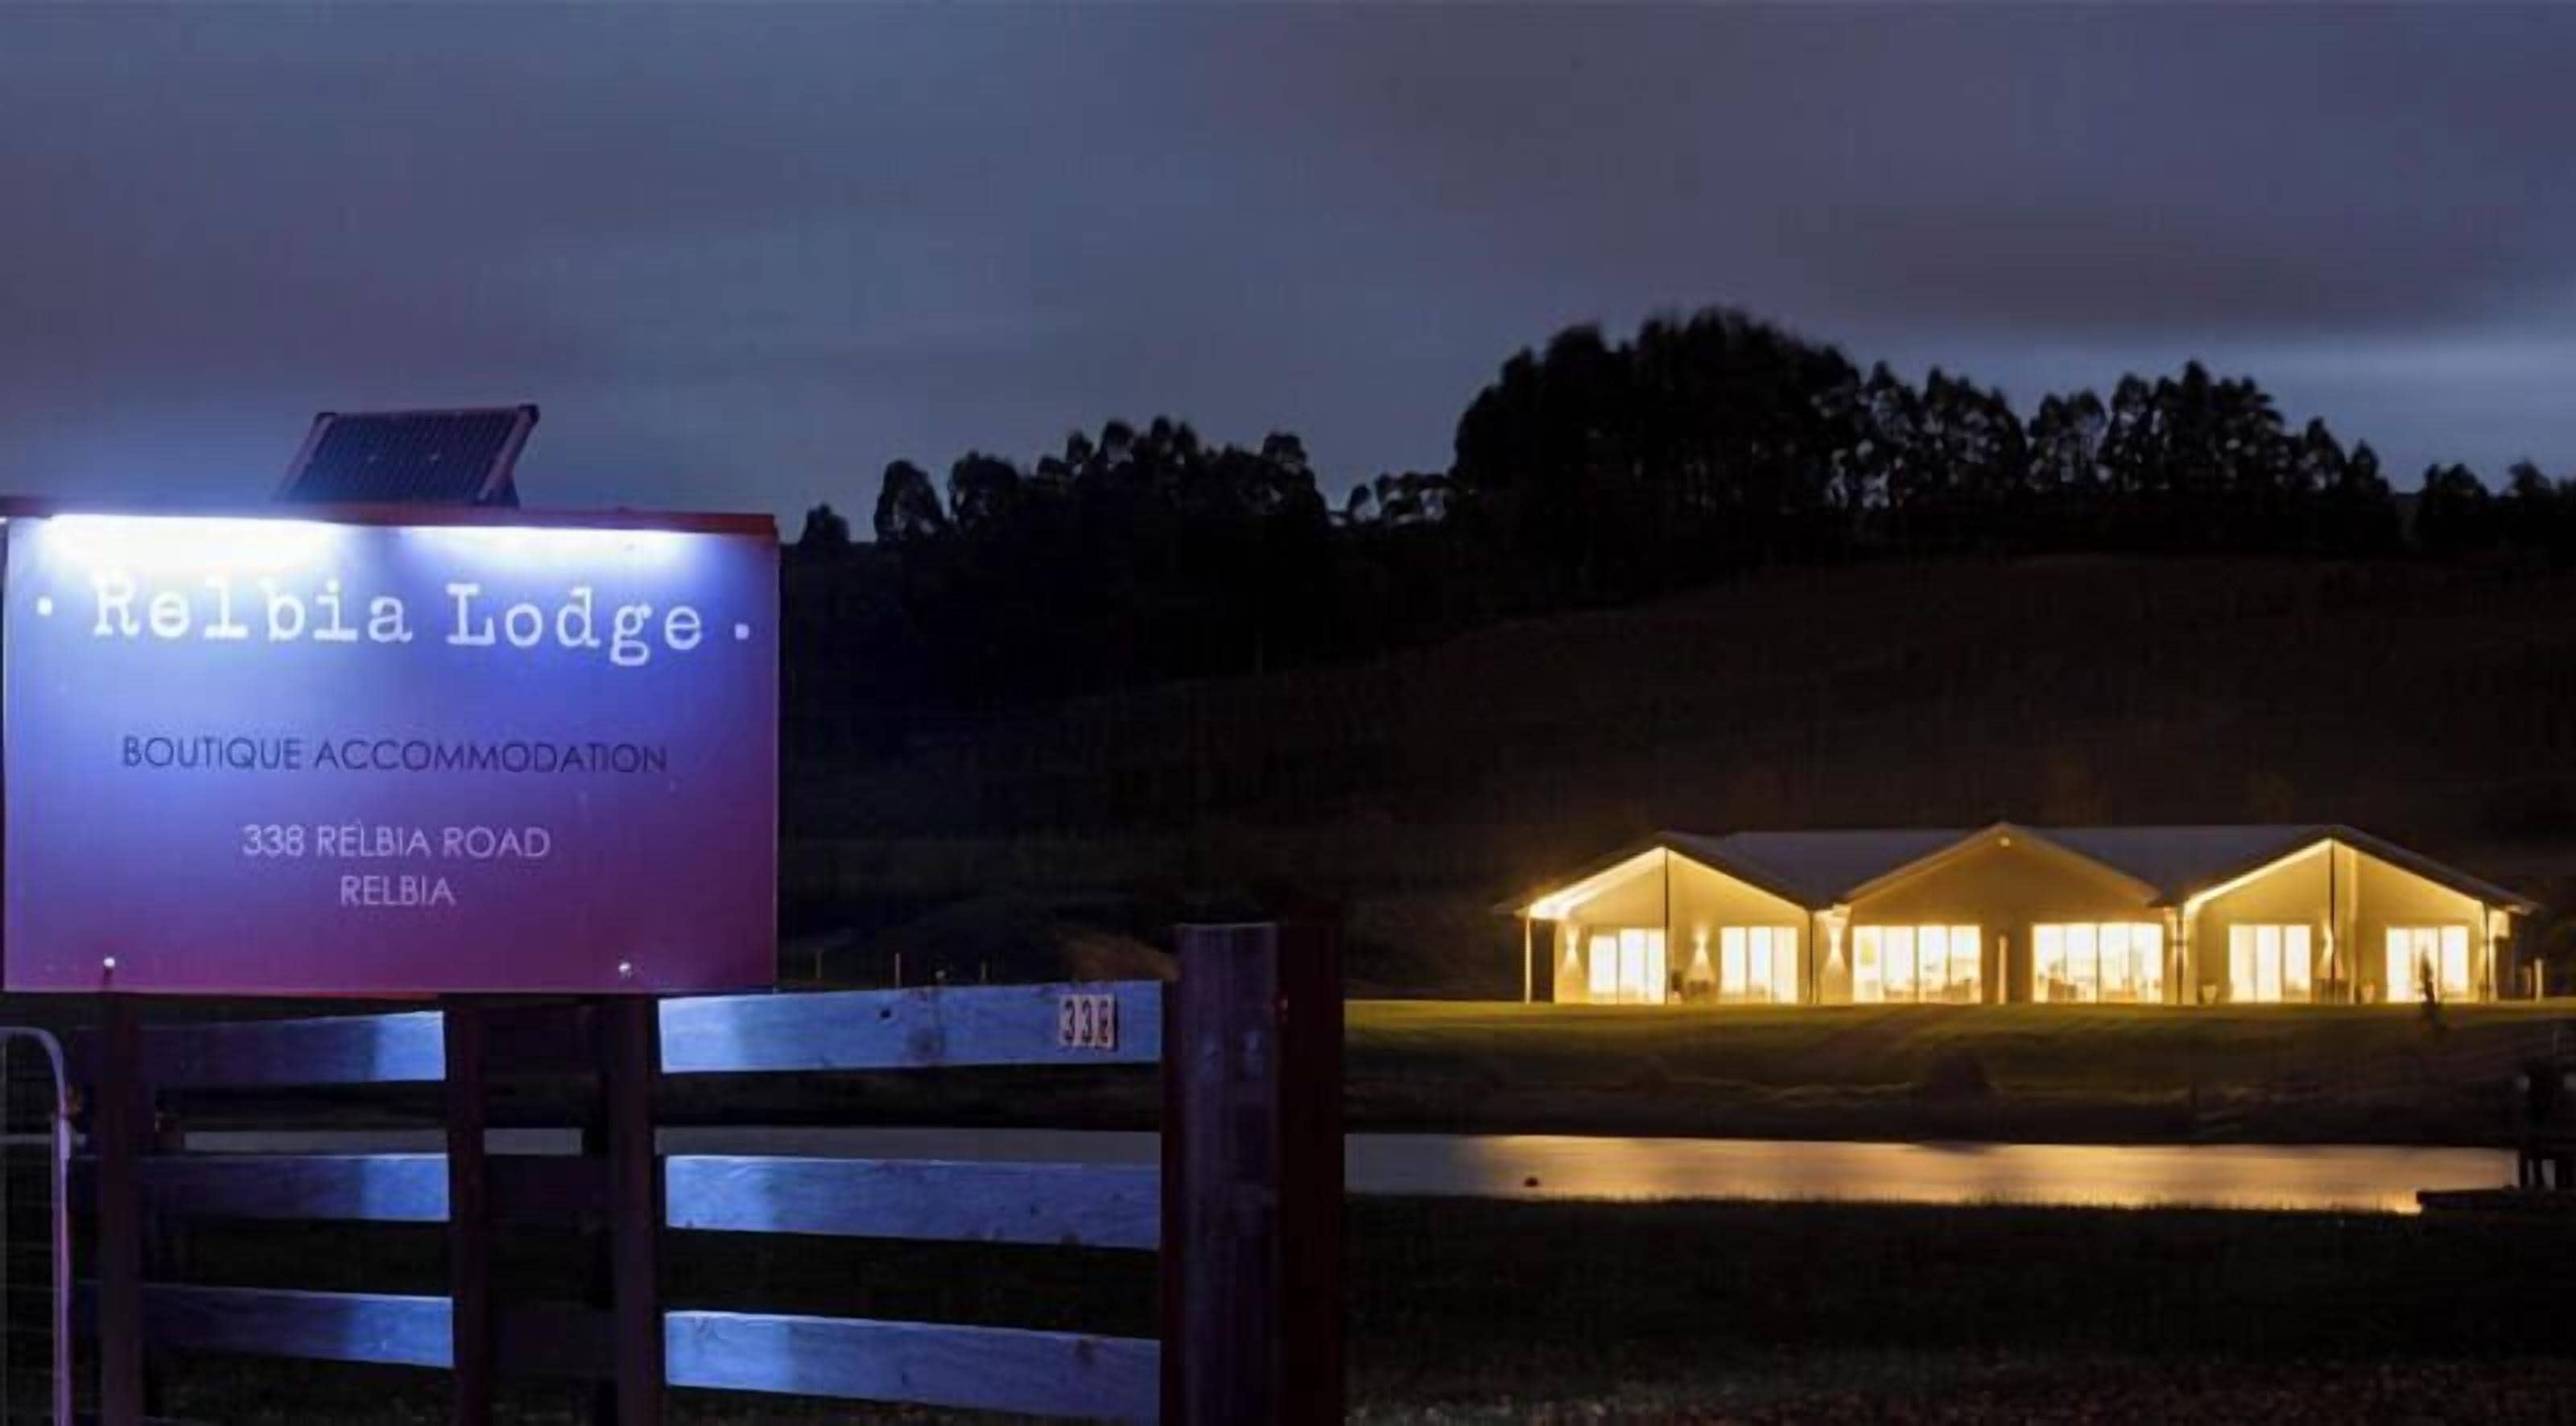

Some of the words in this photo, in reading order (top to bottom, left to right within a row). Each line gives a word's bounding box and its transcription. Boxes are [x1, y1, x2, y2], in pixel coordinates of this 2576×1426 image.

[93, 573, 414, 641] Relbia
[445, 583, 703, 666] Lodge
[122, 736, 302, 773] BOUTIQUE
[314, 739, 667, 775] ACCOMMODATION
[242, 824, 305, 858] 338
[316, 825, 431, 859] RELBIA
[444, 826, 552, 859] ROAD
[340, 875, 456, 907] RELBIA
